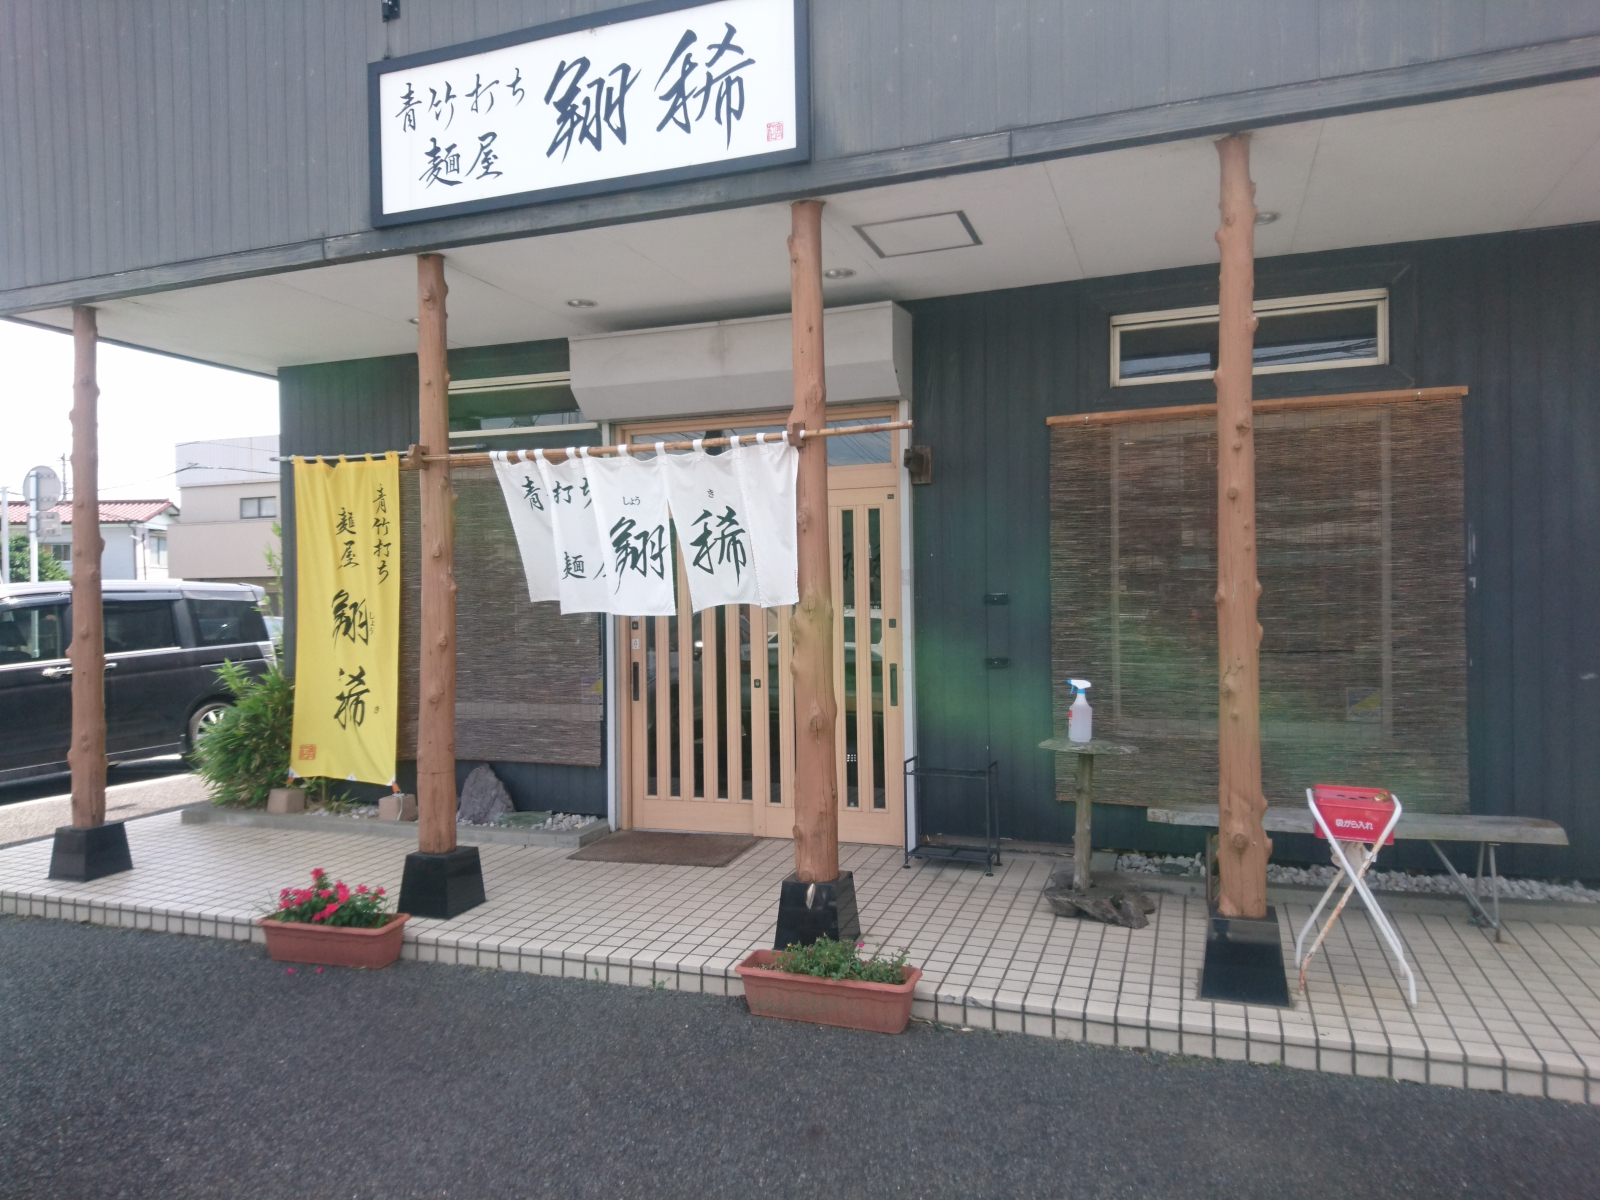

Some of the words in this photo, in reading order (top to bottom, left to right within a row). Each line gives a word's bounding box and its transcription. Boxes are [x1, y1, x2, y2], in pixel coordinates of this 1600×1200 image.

[394, 66, 526, 134] 青竹打ち
[418, 131, 504, 189] 麺屋
[622, 496, 642, 507] しょう
[706, 488, 715, 499] き
[371, 483, 392, 585] 青竹打ち
[1335, 818, 1374, 830] 吸がら入れ
